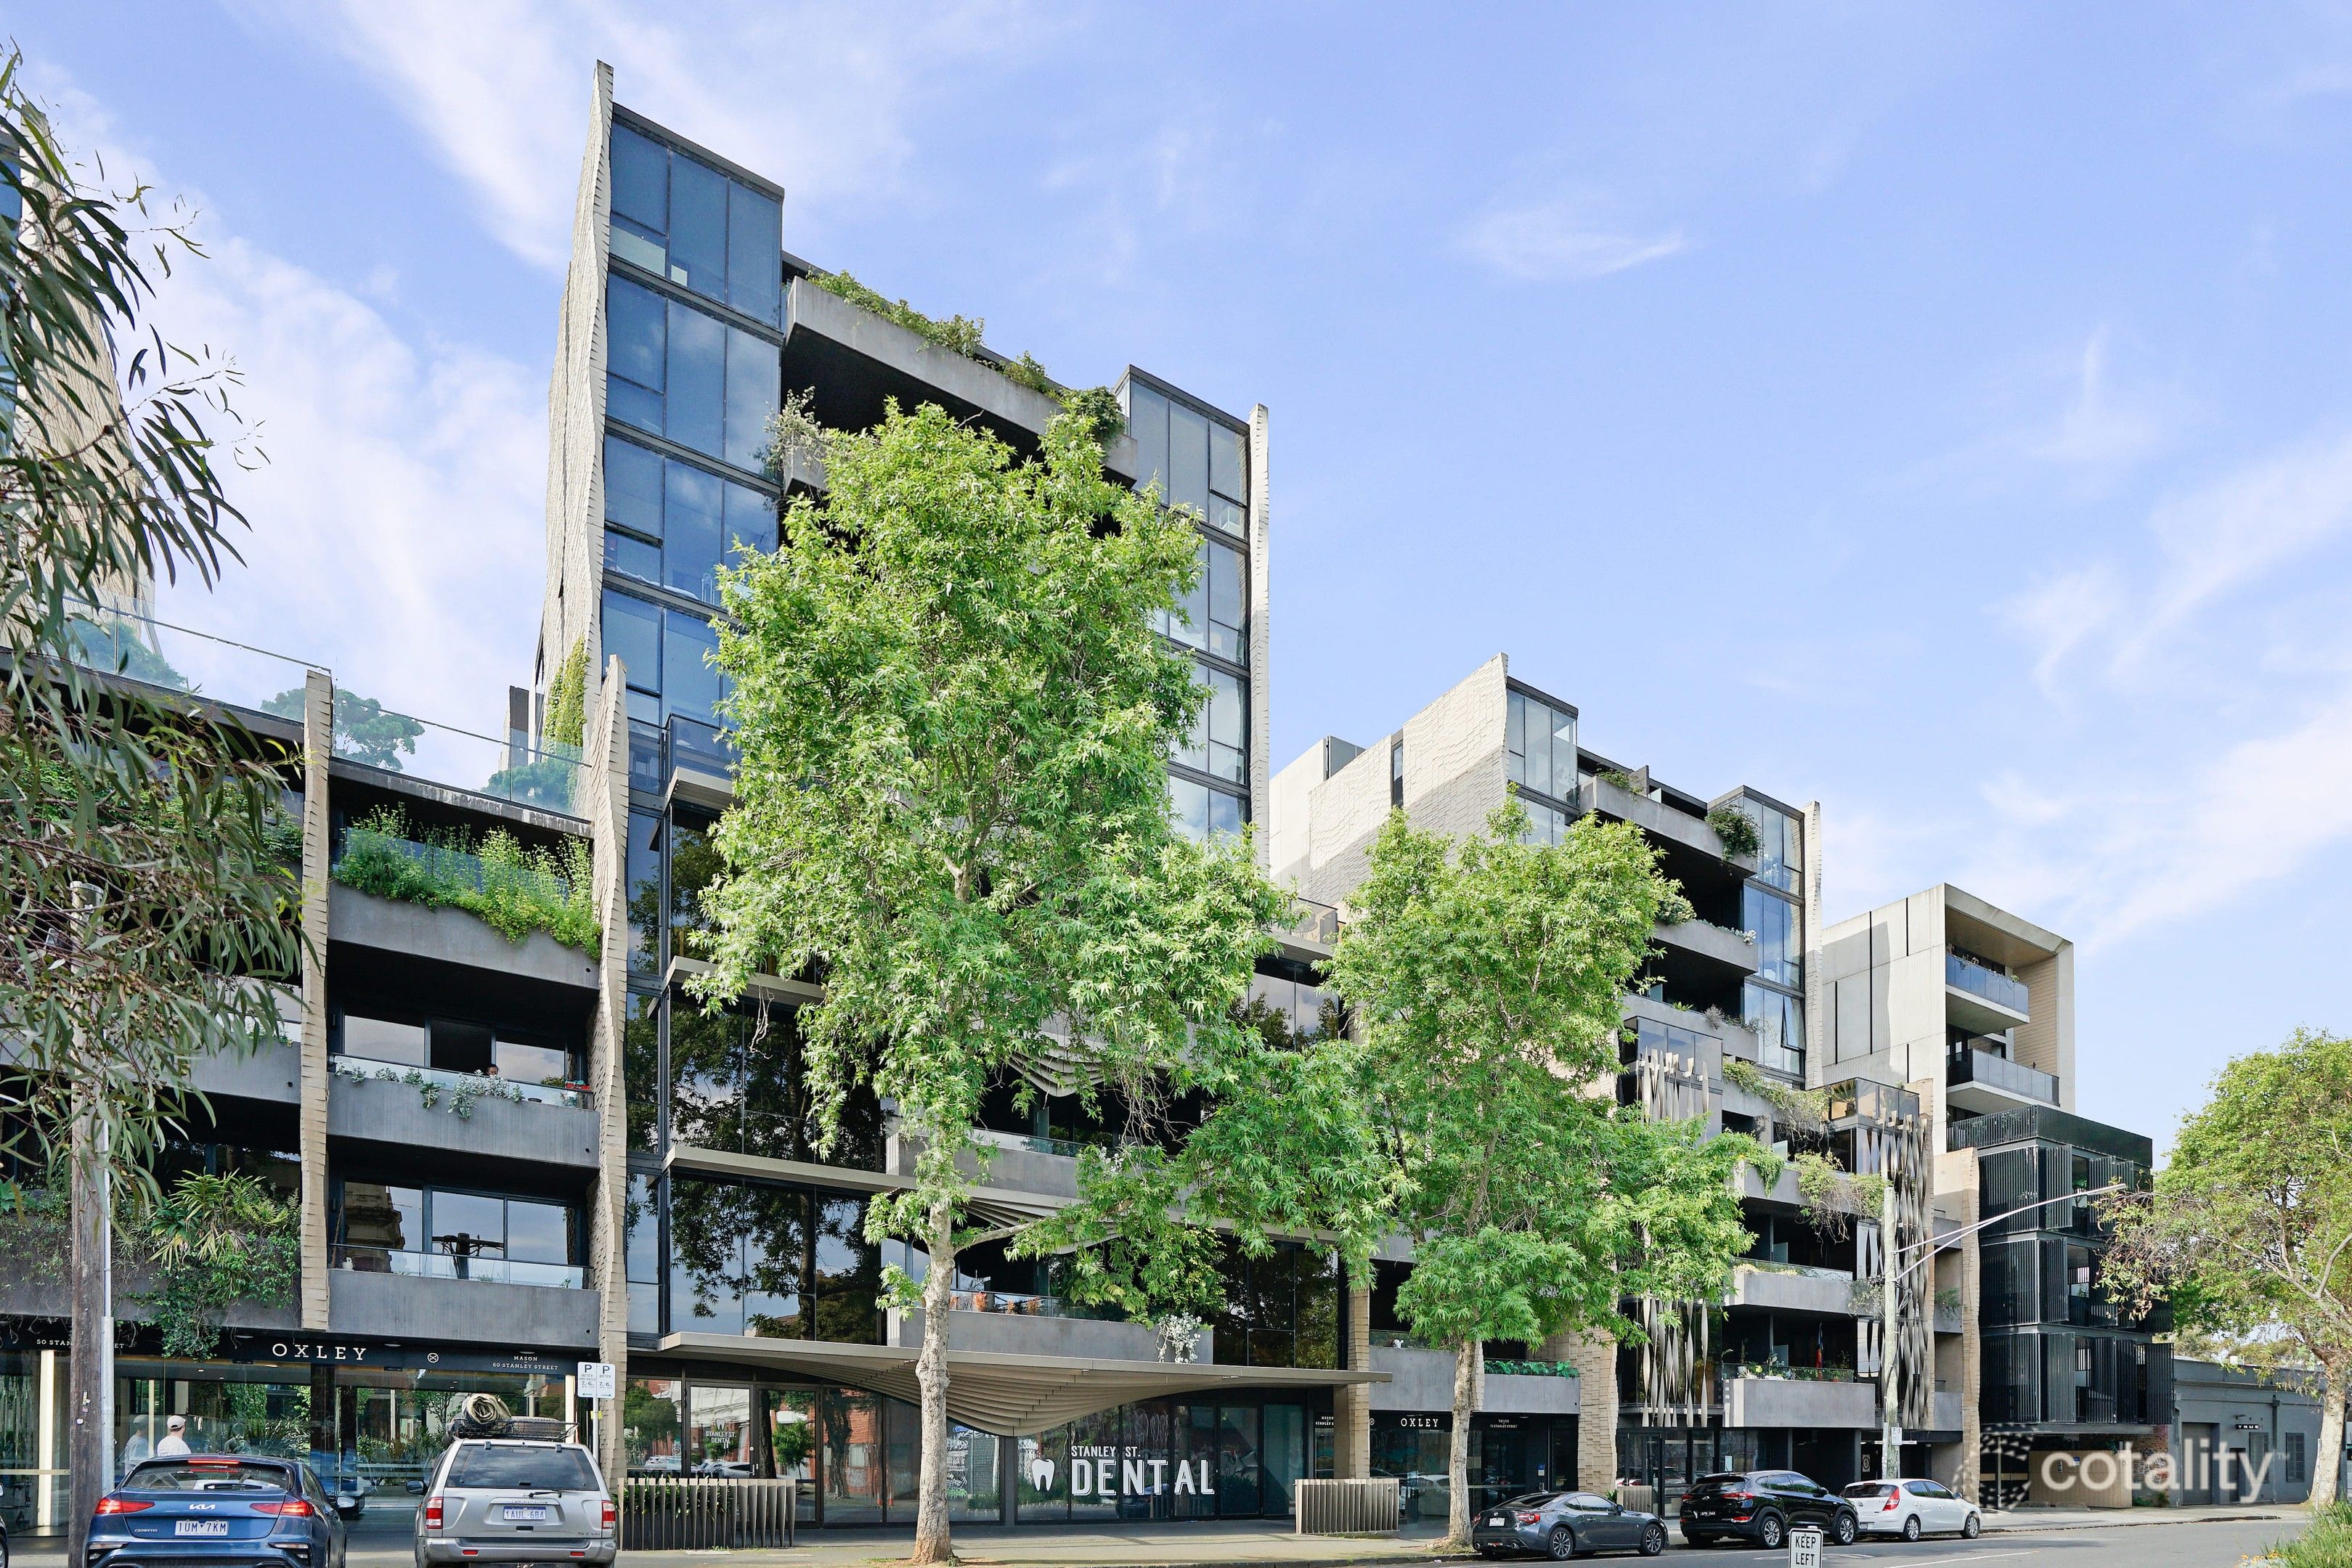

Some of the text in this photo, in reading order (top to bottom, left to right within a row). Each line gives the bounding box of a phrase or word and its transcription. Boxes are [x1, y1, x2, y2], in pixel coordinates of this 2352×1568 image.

[272, 1343, 366, 1360] OXLEY
[585, 1364, 592, 1373] P
[603, 1365, 610, 1374] P
[1401, 1418, 1439, 1427] OXLEY
[1071, 1445, 1141, 1458] STANLEY ST.
[1071, 1458, 1215, 1496] DENTAL
[179, 1522, 227, 1533] 1UM 7KM
[1795, 1535, 1816, 1549] KEEP
[1796, 1552, 1815, 1567] LEFT
